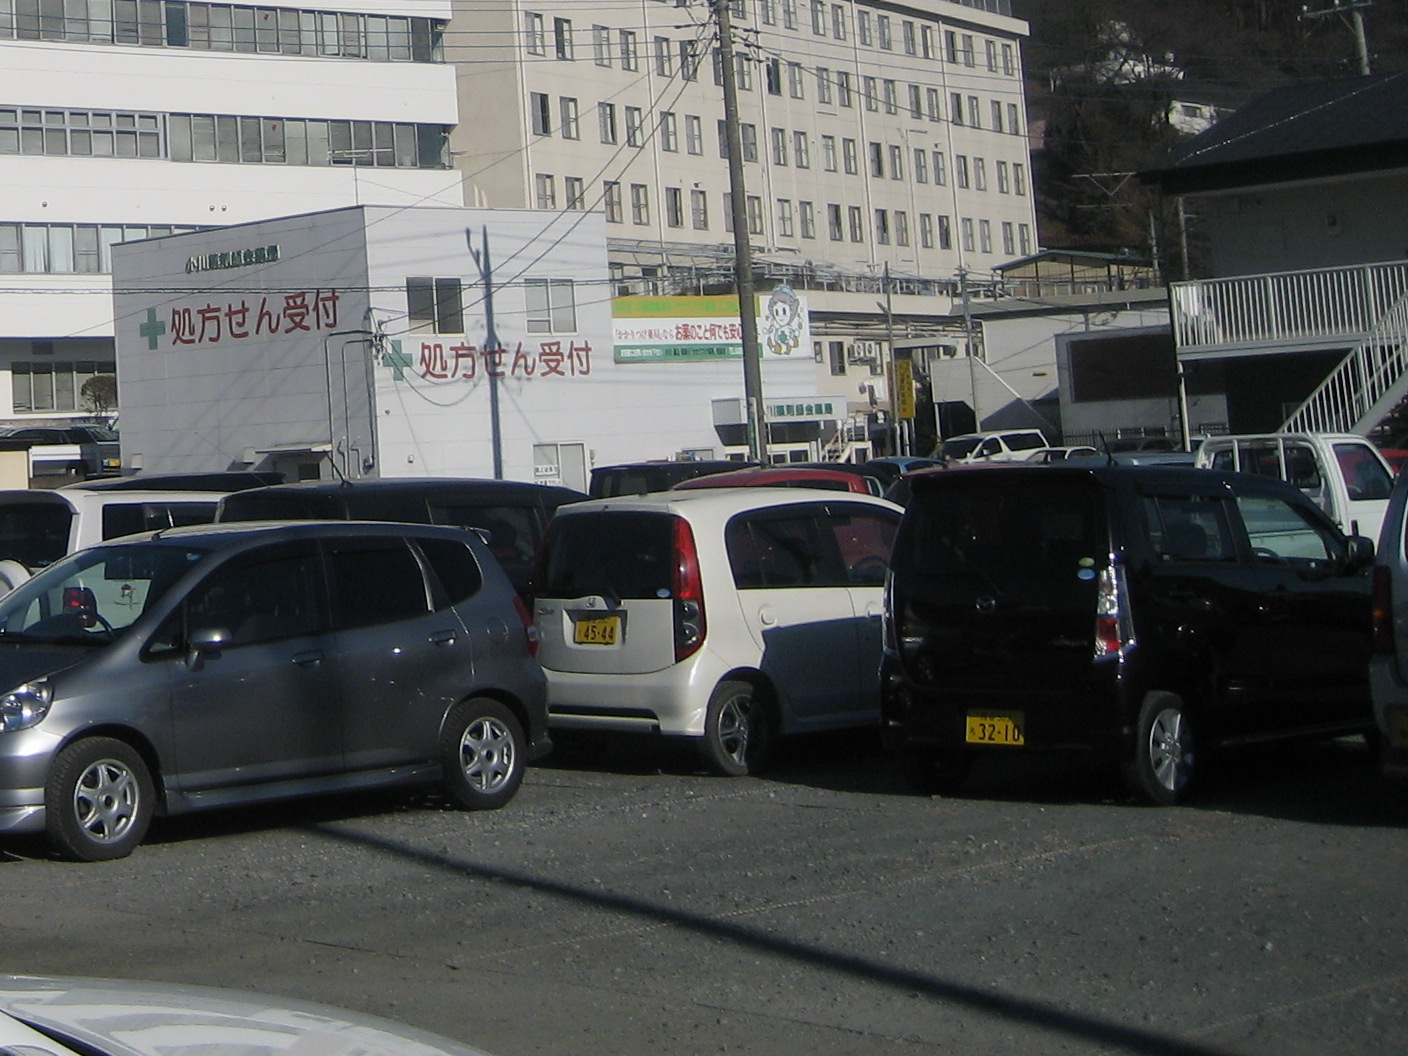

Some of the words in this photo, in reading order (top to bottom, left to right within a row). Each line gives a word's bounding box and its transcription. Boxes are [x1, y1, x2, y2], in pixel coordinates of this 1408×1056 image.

[171, 289, 340, 345] 処方せん受付
[420, 340, 592, 379] 処方せん受付
